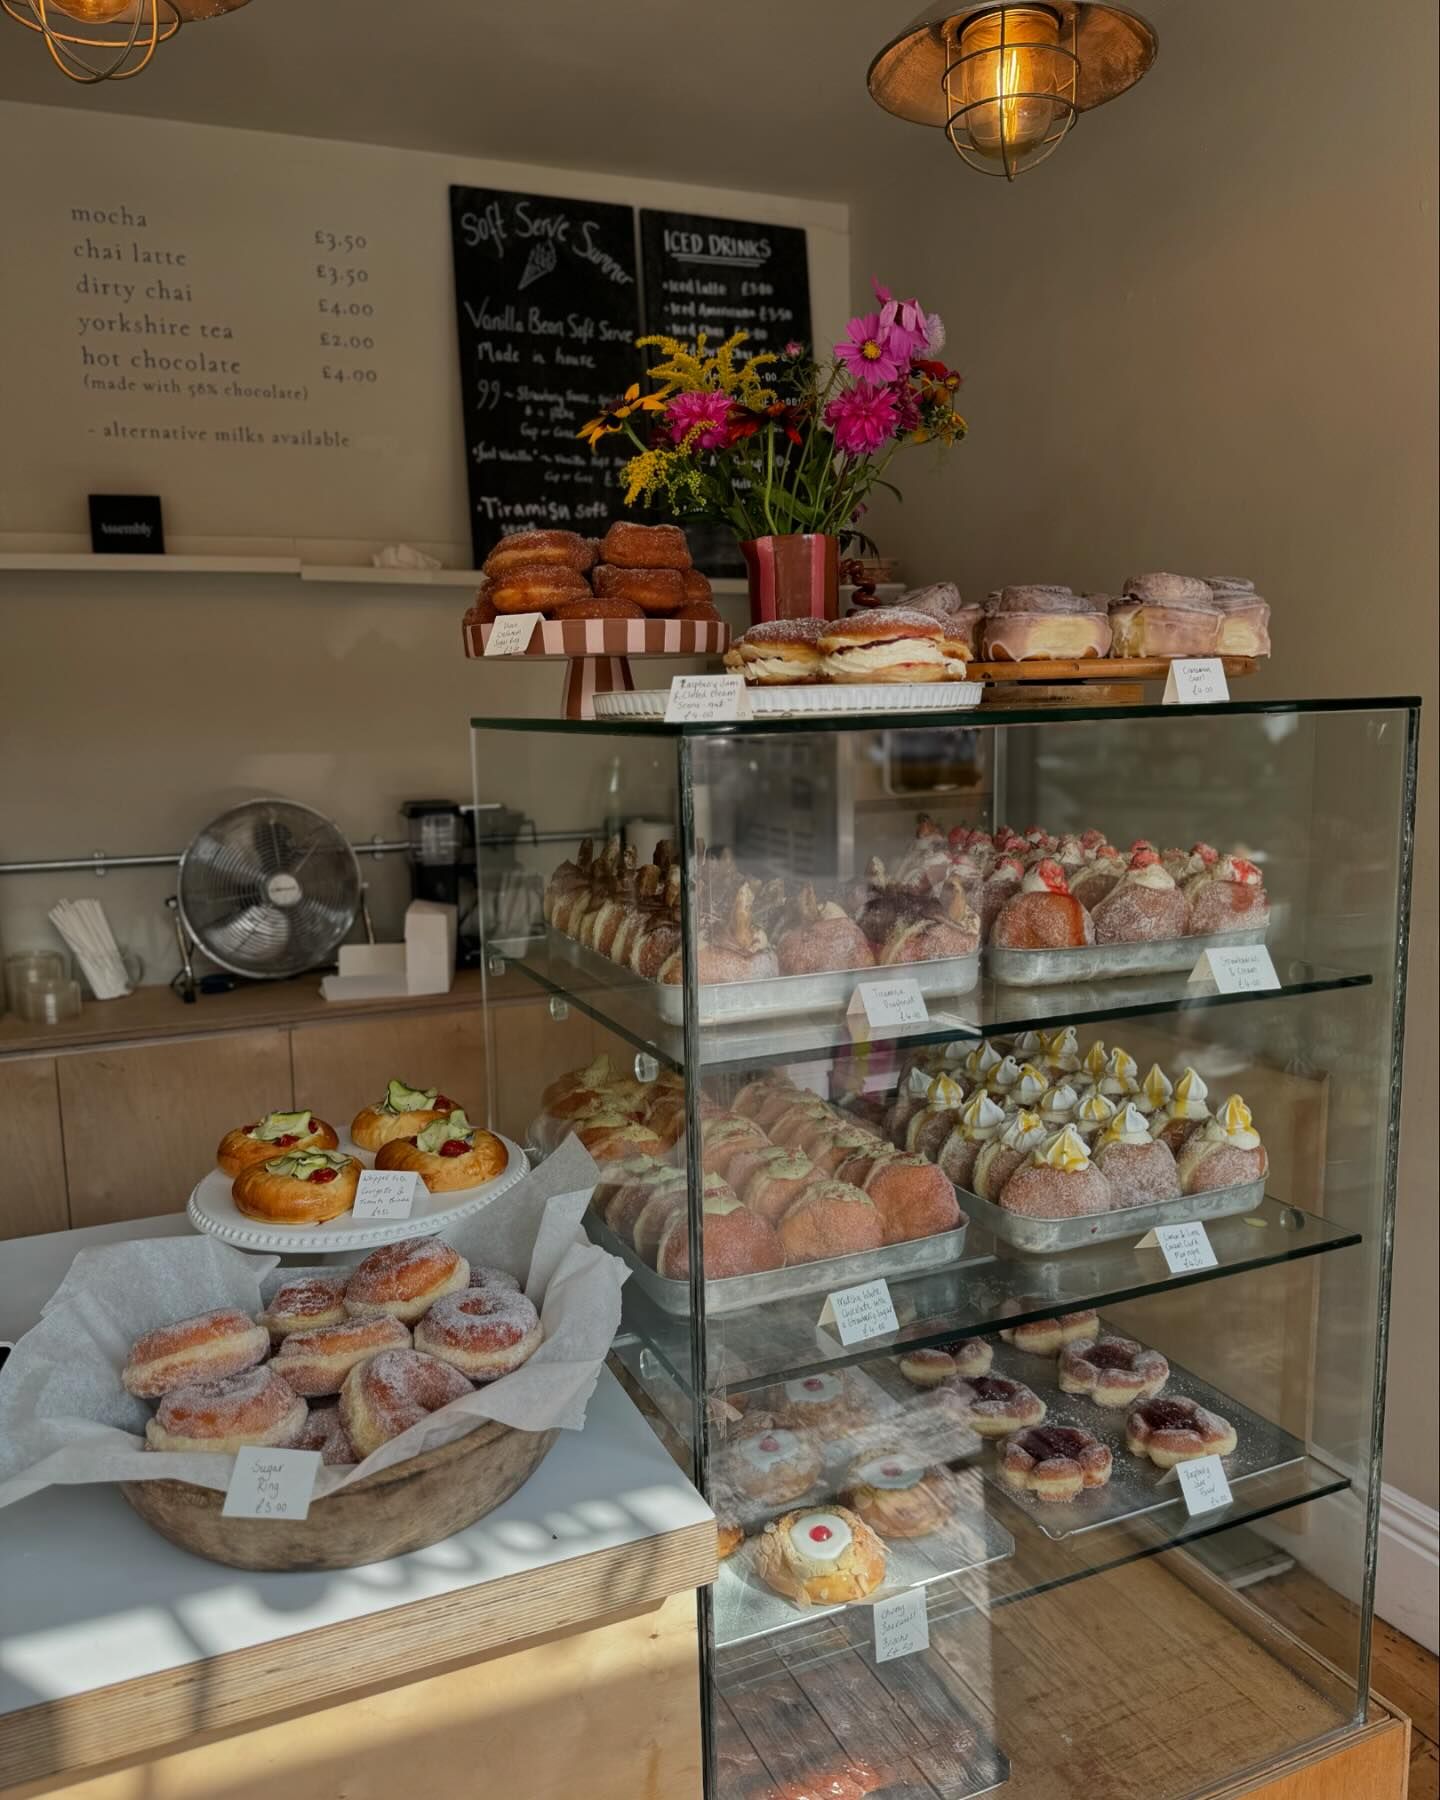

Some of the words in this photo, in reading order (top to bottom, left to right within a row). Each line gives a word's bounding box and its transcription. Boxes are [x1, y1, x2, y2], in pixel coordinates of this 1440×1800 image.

[71, 206, 148, 228] mocha
[461, 201, 507, 259] Soft
[515, 201, 570, 242] Serve
[74, 237, 123, 262] chai
[133, 242, 187, 267] latte
[314, 230, 368, 252] £3.50
[664, 229, 703, 255] ICED
[708, 234, 772, 259] DRINKS
[316, 263, 369, 286] £3.50
[668, 278, 695, 294] Iced
[76, 274, 136, 304] dirty
[145, 278, 193, 302] chai
[318, 298, 374, 317] £4.00
[464, 296, 525, 333] Vanilla
[528, 306, 564, 336] Bean
[567, 312, 595, 344] Soft
[598, 319, 633, 343] Serve
[670, 301, 696, 317] Iced
[78, 311, 191, 338] yorkshire
[200, 321, 234, 340] tea
[319, 331, 375, 350] £2.00
[81, 346, 120, 368] hot
[130, 348, 241, 374] chocolate
[478, 341, 520, 363] Made
[555, 346, 597, 369] house
[83, 373, 137, 392] (made
[143, 378, 181, 394] with
[223, 384, 310, 401] chocolate)
[322, 365, 378, 384] £4.00
[477, 379, 500, 411] 99
[103, 421, 208, 443] alternative
[214, 427, 265, 445] milks
[271, 430, 351, 449] available
[575, 502, 609, 519] soft
[251, 1458, 285, 1480] Sugar
[256, 1476, 280, 1500] Ring
